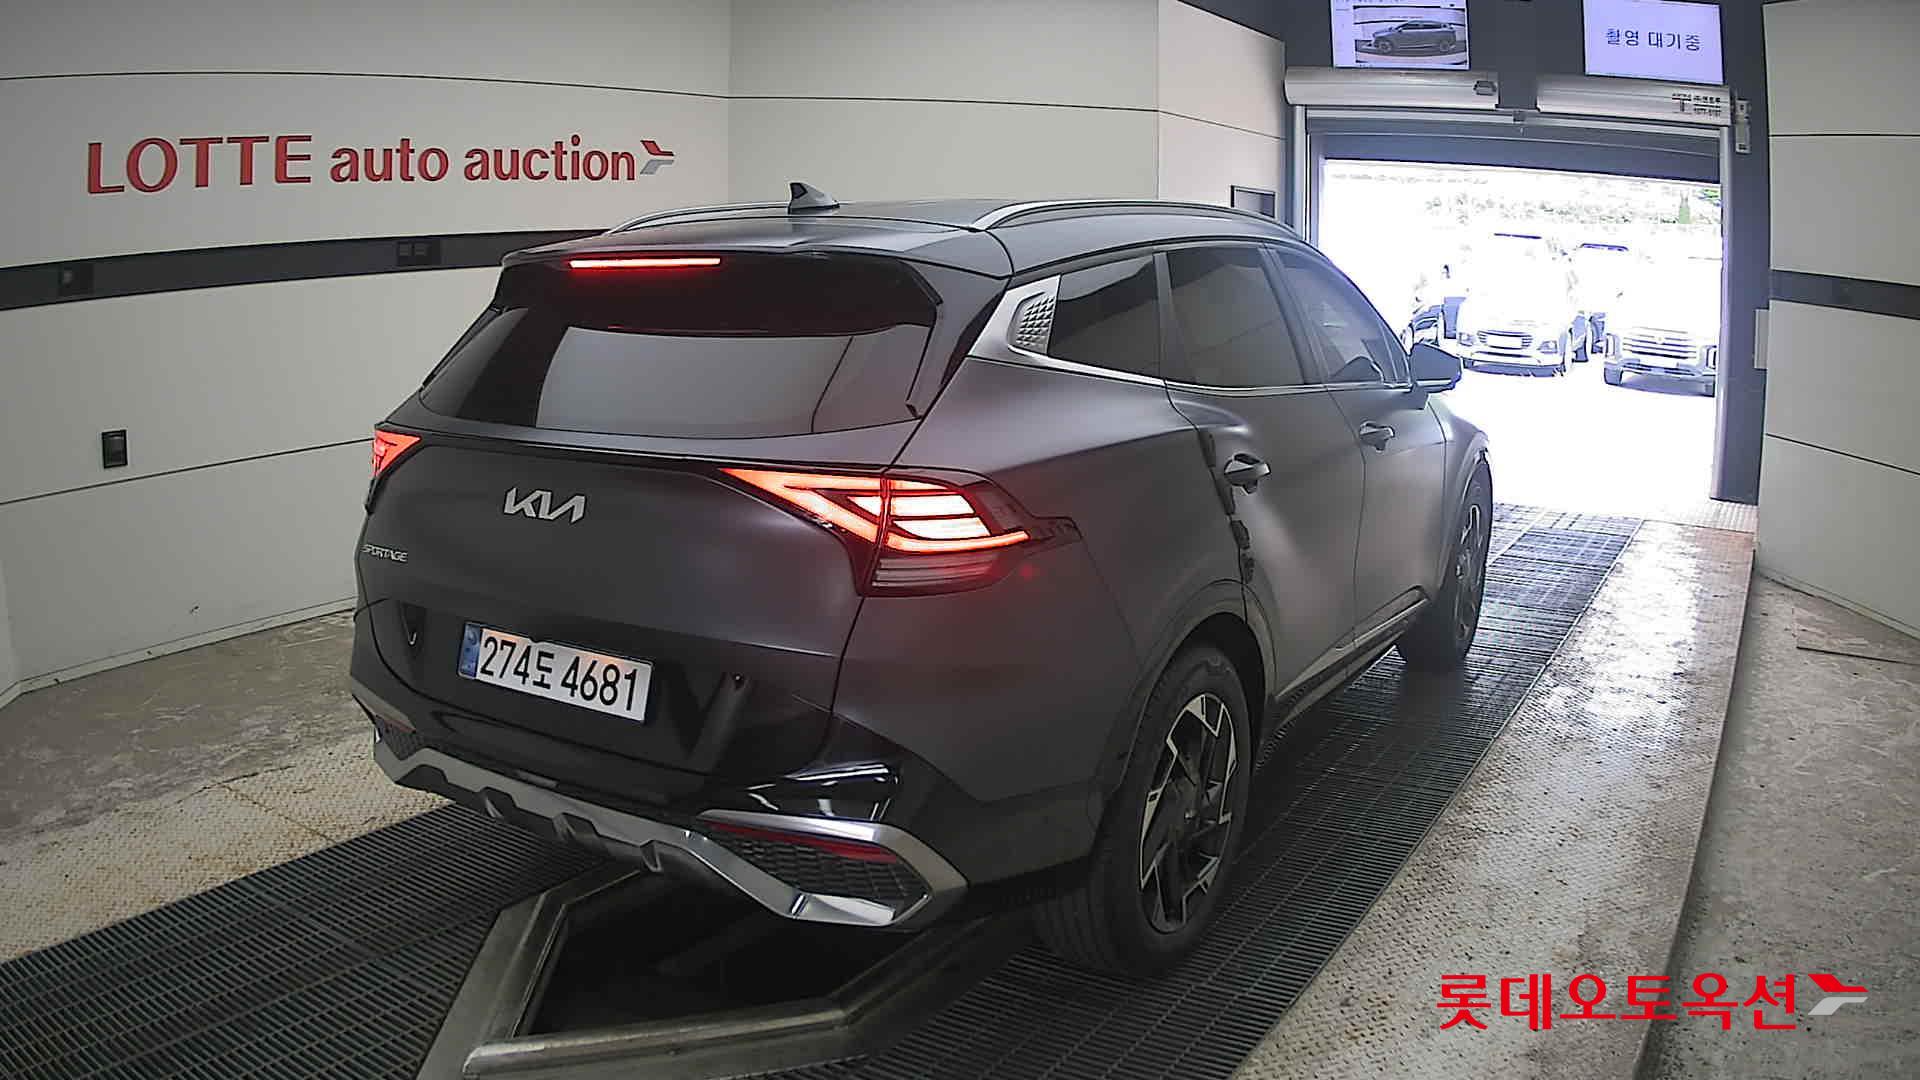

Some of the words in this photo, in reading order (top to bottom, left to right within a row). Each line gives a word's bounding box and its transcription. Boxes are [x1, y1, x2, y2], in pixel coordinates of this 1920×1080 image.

[1648, 31, 1701, 51] 대기중
[87, 135, 312, 194] LOTTE
[329, 138, 449, 182] auto
[463, 134, 636, 181] auction
[503, 487, 586, 524] KIA
[363, 544, 408, 562] SPORTAGE
